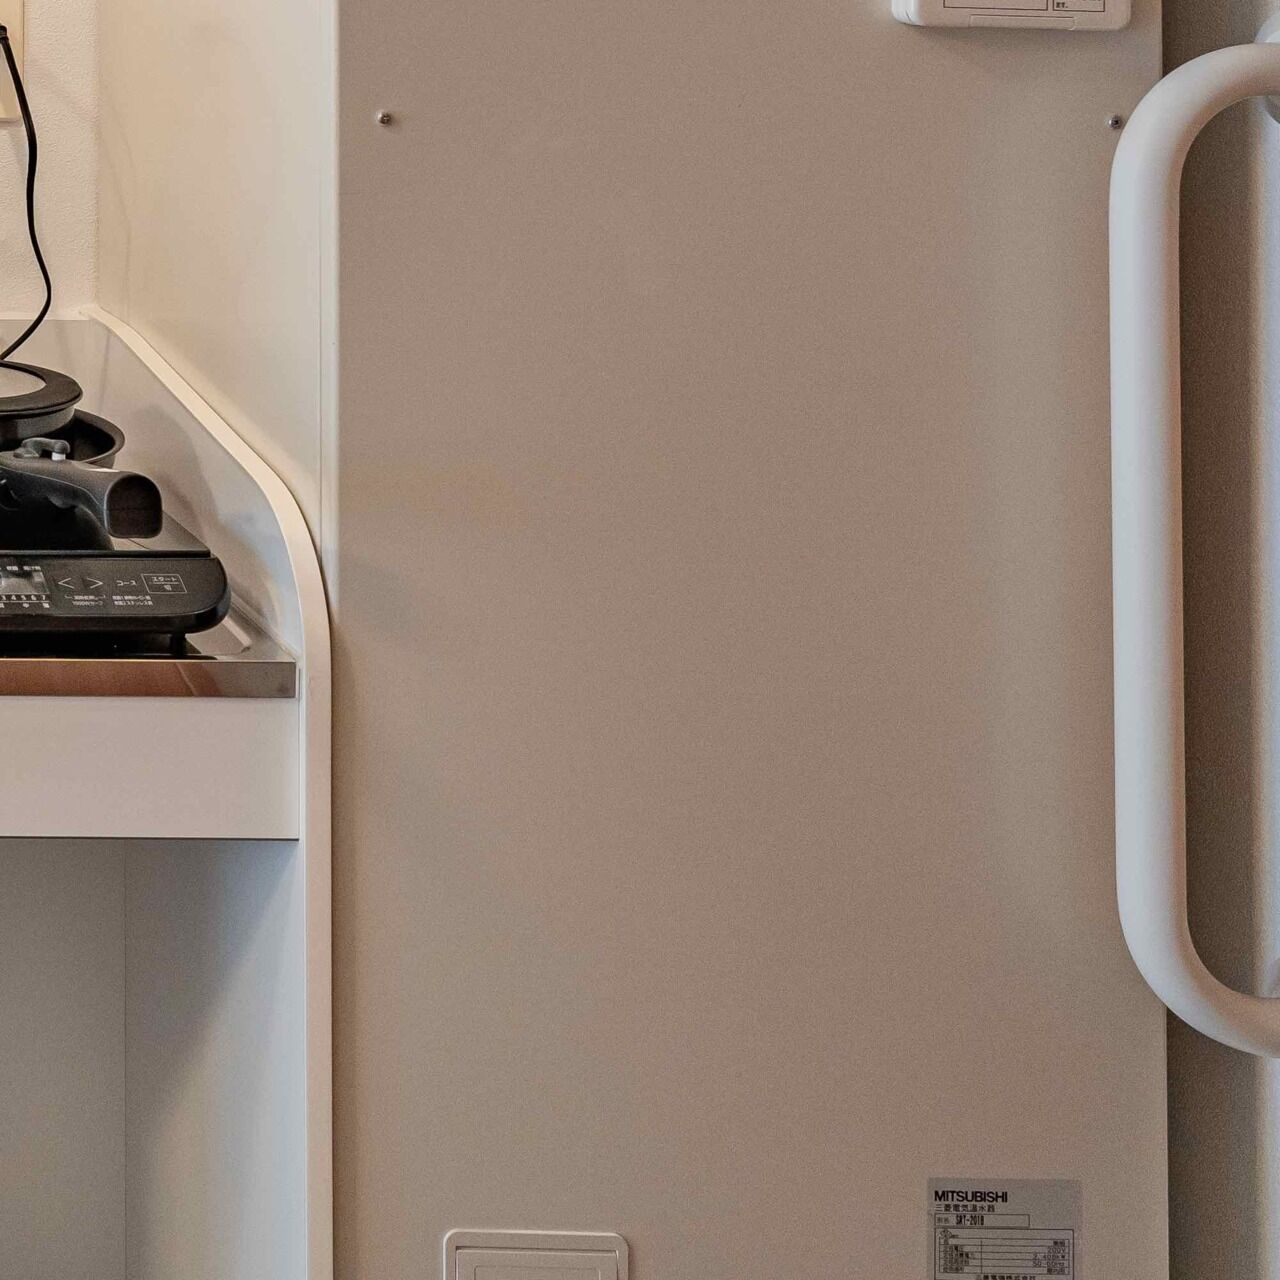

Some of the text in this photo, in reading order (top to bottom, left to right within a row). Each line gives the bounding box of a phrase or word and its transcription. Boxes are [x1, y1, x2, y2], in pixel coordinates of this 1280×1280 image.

[934, 1190, 1007, 1202] MITSUBISHI
[936, 1204, 995, 1212] 三菱電気温水器
